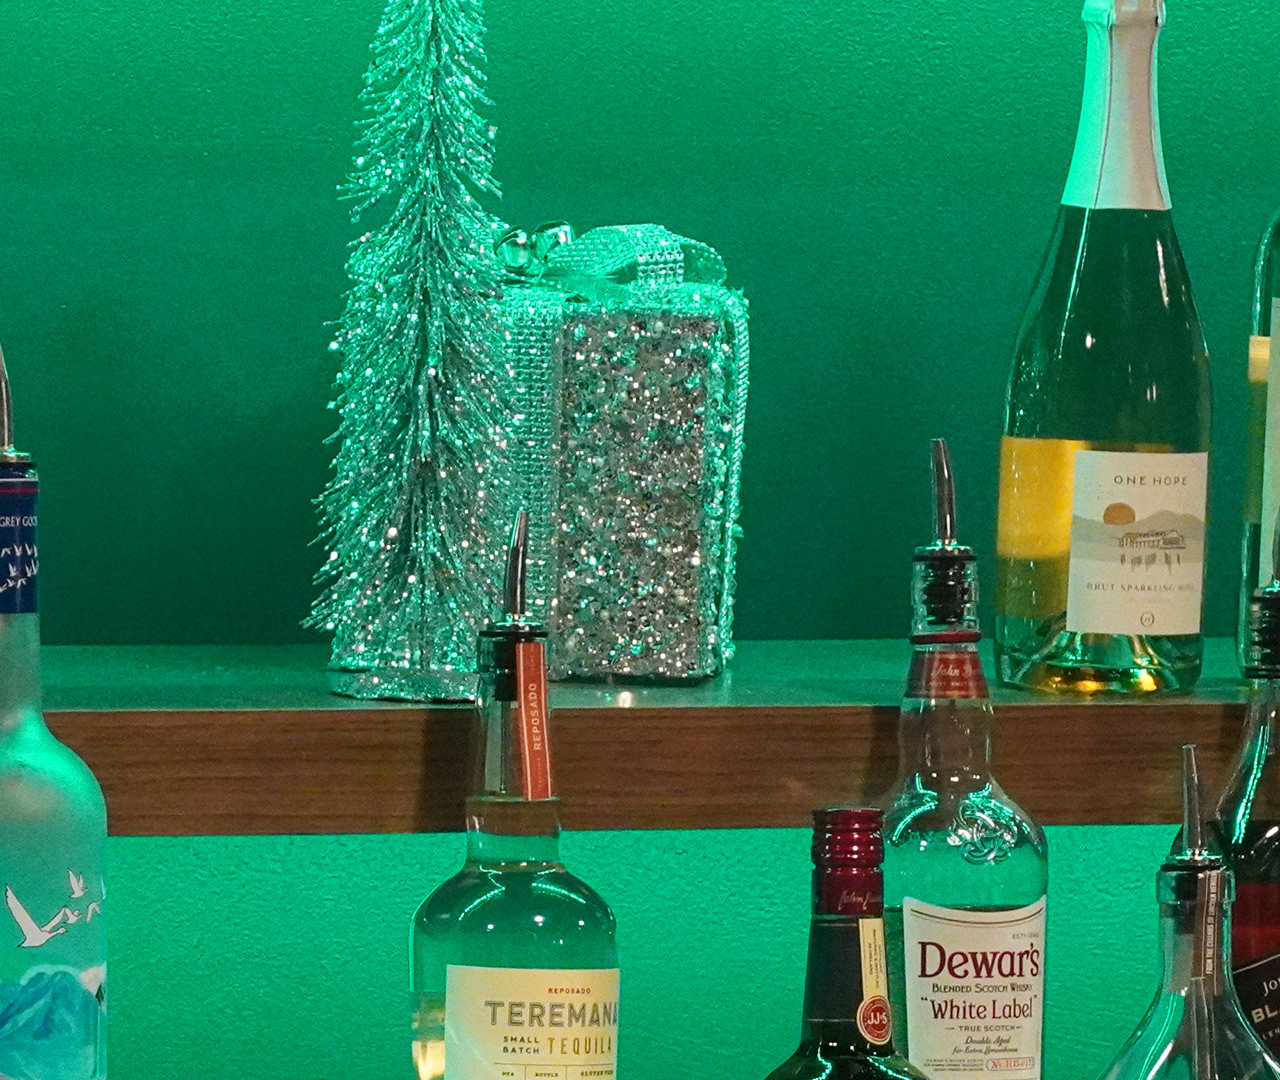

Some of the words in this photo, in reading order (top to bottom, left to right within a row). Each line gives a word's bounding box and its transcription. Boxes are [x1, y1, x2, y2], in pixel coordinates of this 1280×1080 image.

[1113, 475, 1146, 486] ONE
[1153, 476, 1187, 486] HOPE
[529, 683, 542, 750] REPOSADO
[918, 941, 1040, 979] Dewar's
[932, 984, 972, 993] BLENDED
[974, 983, 1008, 993] SCOTCH
[1010, 983, 1032, 993] WHISKY
[984, 1024, 1015, 1032] SCOTCH
[503, 1036, 539, 1044] SMALL
[965, 1035, 992, 1045] Double
[503, 1046, 540, 1054] BATCH
